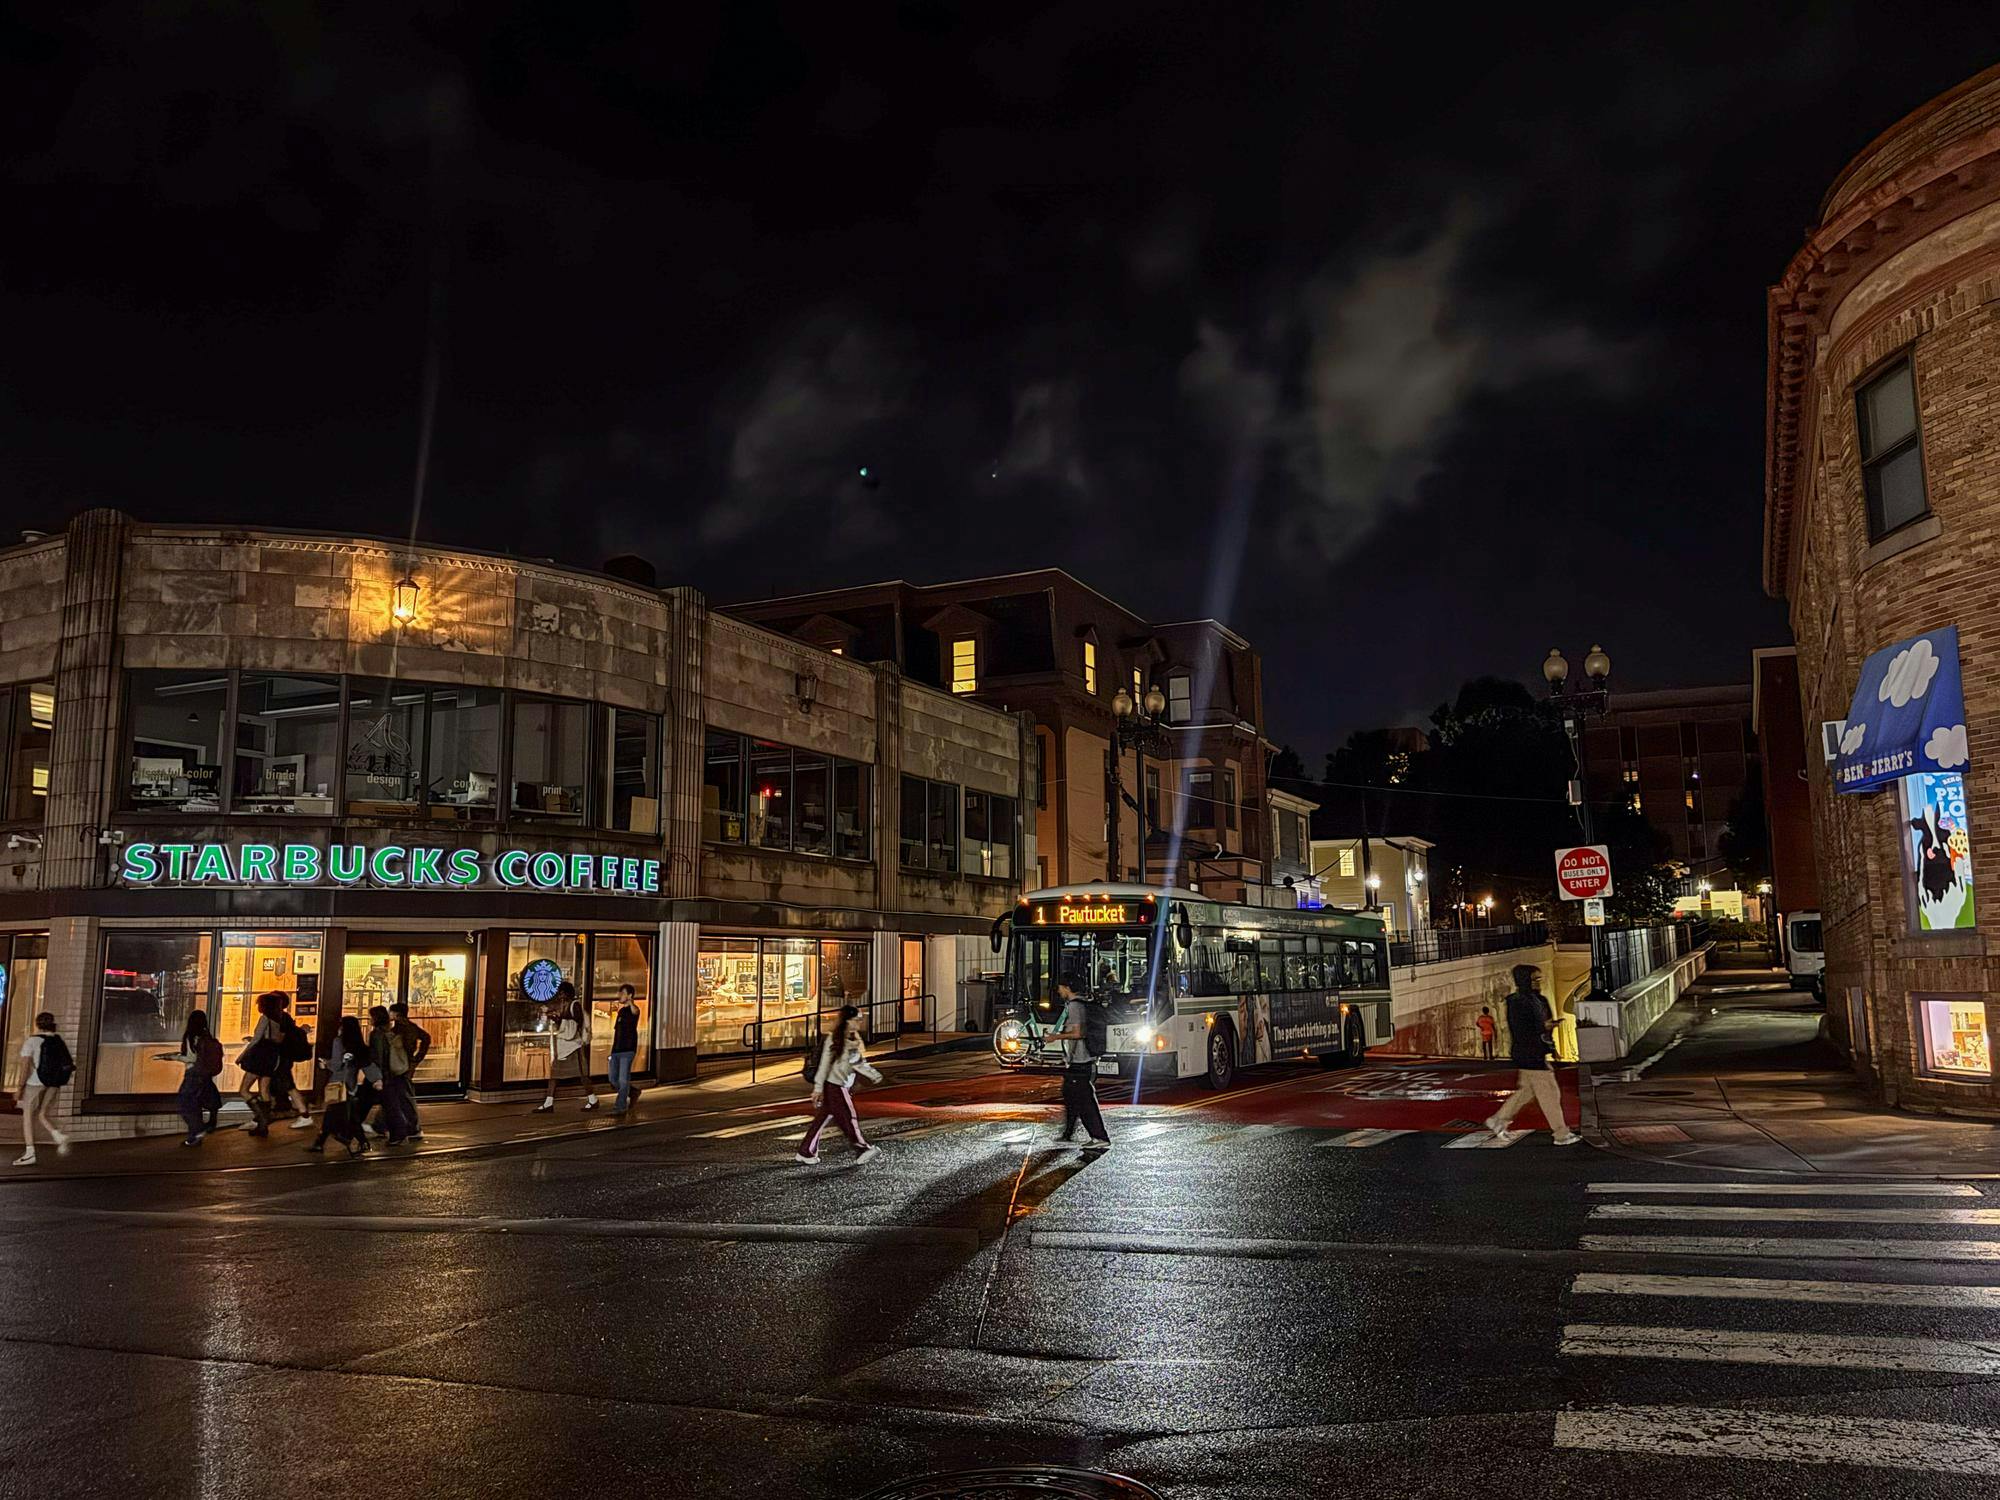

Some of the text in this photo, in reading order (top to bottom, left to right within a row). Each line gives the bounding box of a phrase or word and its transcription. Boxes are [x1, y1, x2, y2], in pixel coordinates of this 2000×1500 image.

[1844, 764, 1864, 783] BEN
[1872, 751, 1913, 776] JERRY'S
[367, 772, 401, 787] design
[542, 784, 562, 797] print
[122, 843, 660, 892] STARBUCKS COFFEE
[1564, 856, 1600, 867] DO NOT
[1563, 870, 1584, 878] BUSES
[1570, 879, 1600, 888] ENTER
[1036, 905, 1125, 923] 1 Pawtucket
[1273, 1026, 1284, 1040] The
[1285, 1024, 1306, 1043] perfect
